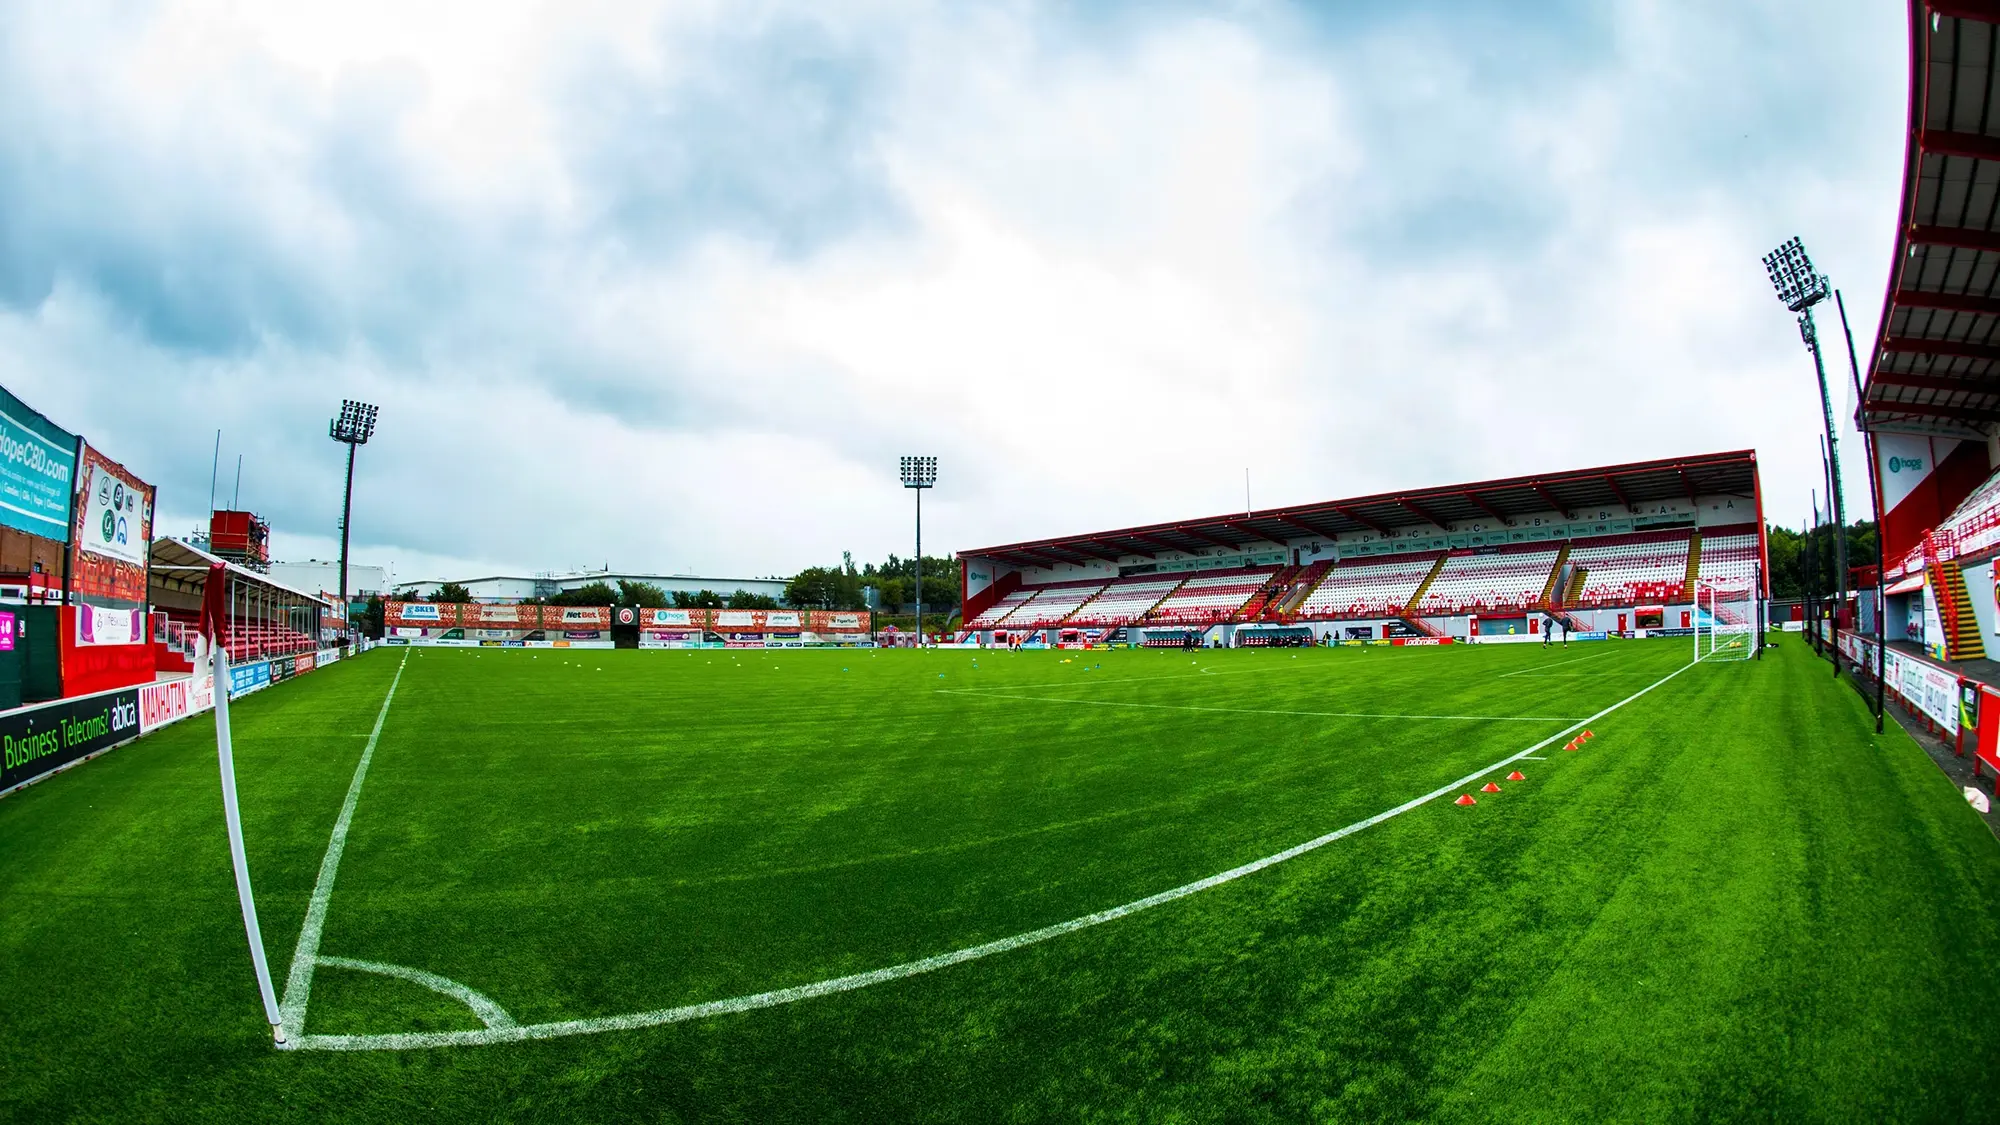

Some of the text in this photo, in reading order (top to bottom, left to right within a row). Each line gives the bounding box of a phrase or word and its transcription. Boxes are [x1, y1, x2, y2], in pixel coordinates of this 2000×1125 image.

[1404, 638, 1439, 646] Ladbrokes
[142, 680, 188, 728] MANHATTAN
[4, 697, 136, 770] Business Telecoms? abica
